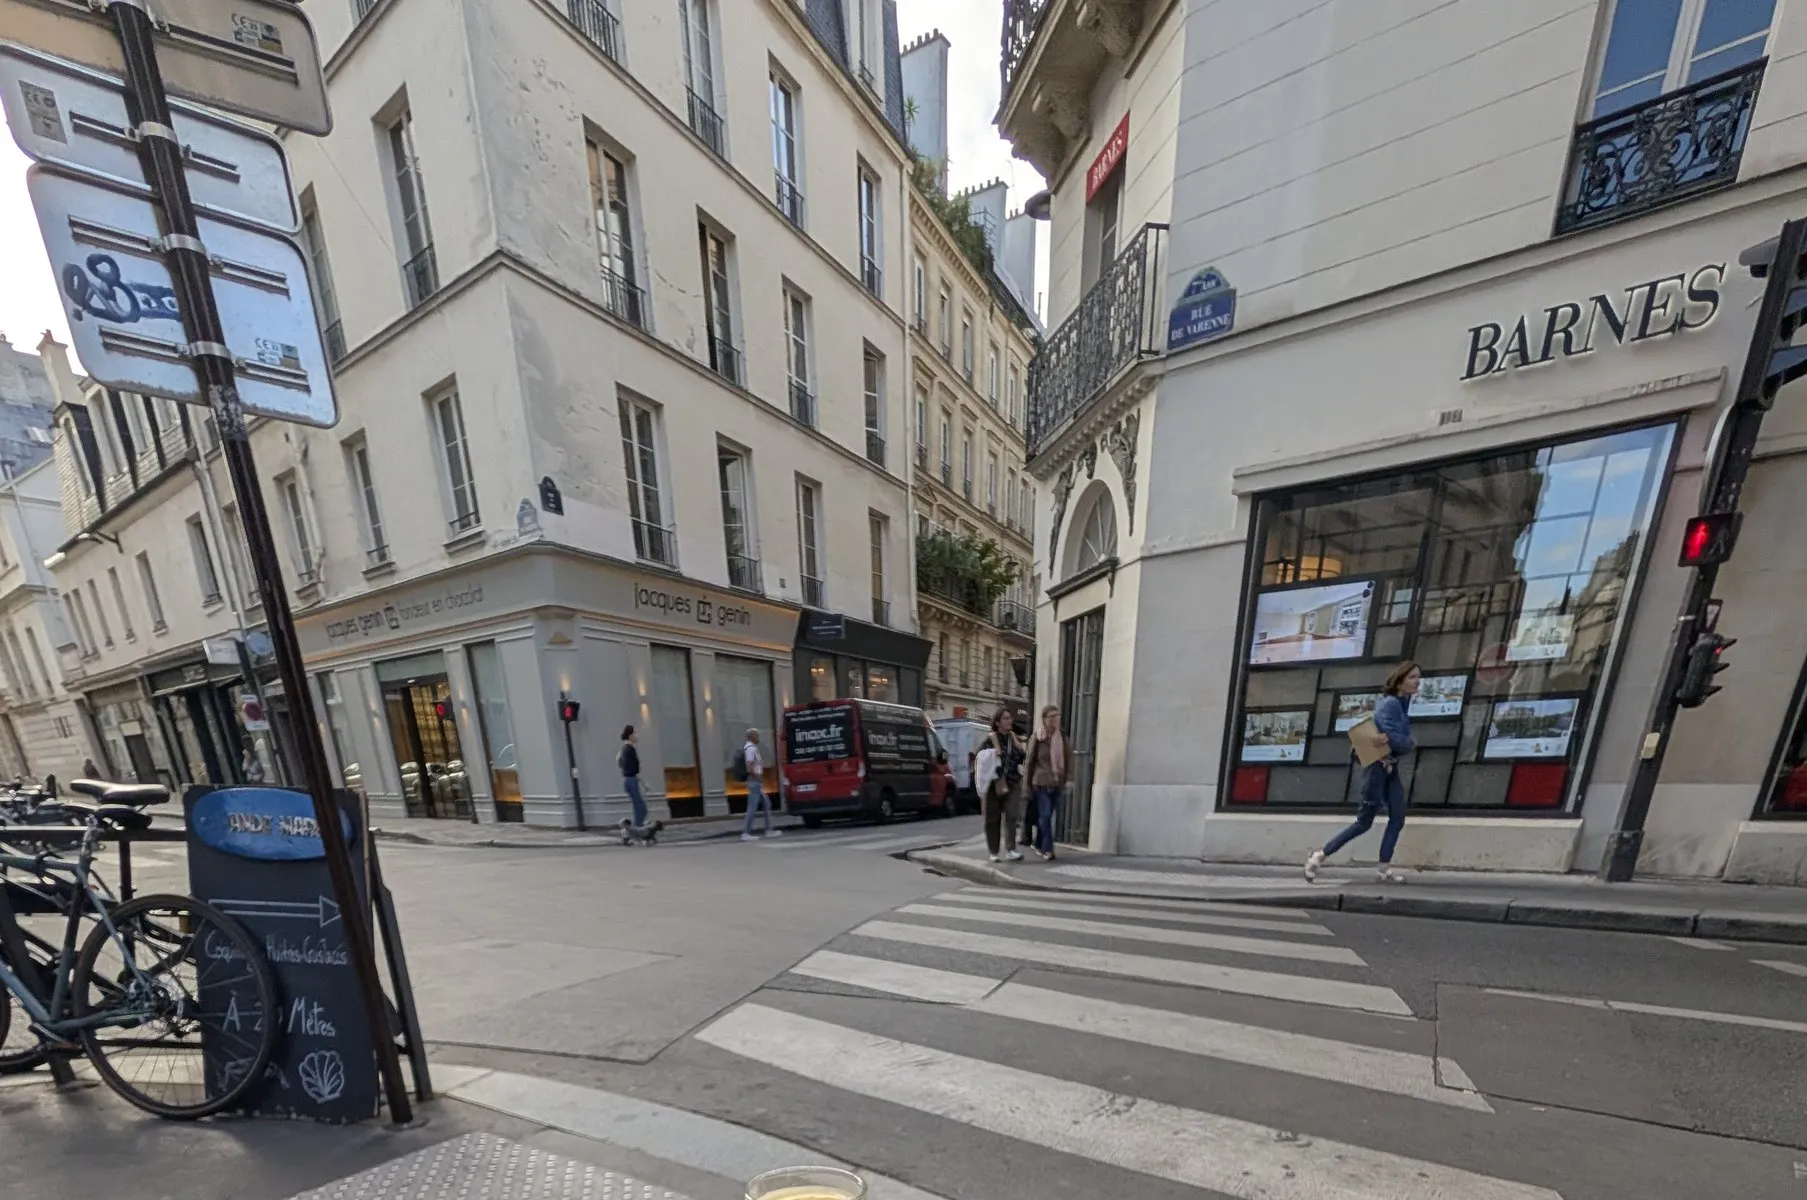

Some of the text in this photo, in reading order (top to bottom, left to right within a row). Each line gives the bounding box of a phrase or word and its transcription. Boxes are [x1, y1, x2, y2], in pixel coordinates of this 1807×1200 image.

[1171, 312, 1231, 341] DE VARENNE
[1191, 304, 1213, 321] RUE
[1460, 262, 1726, 381] BARNES
[634, 581, 751, 626] jacques genin
